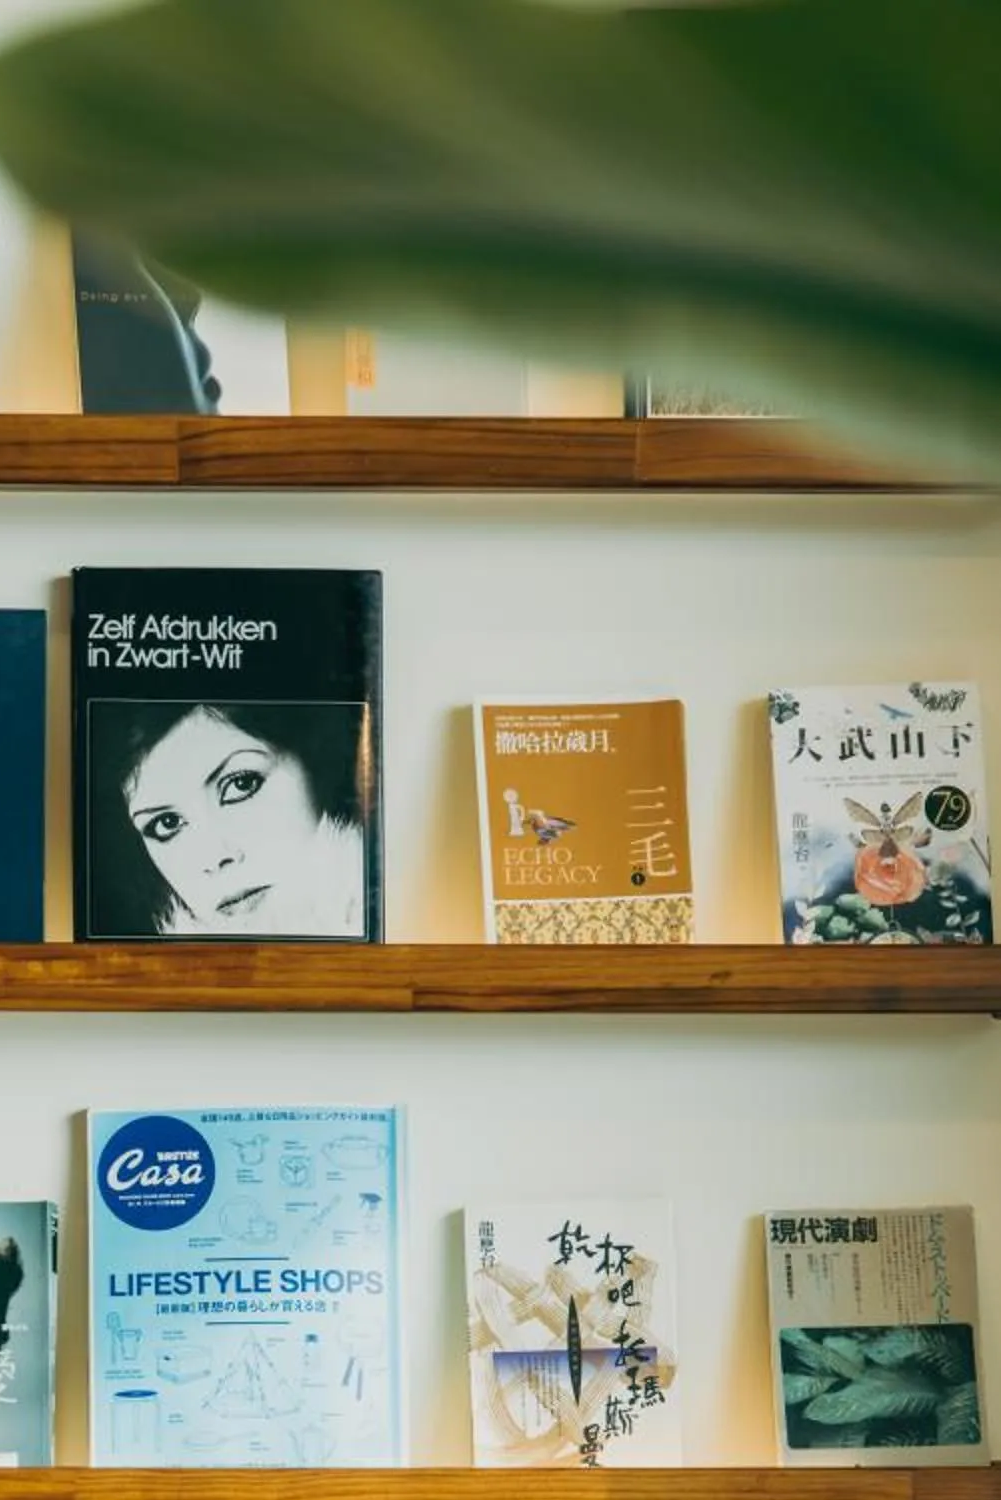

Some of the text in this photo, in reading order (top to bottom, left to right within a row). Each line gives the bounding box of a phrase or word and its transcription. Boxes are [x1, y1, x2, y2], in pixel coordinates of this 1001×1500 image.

[87, 613, 277, 641] Zelf Afdrukken
[87, 643, 244, 669] in Zwart-Wit
[787, 722, 975, 764] 大武山下
[625, 785, 679, 877] 三毛
[503, 846, 573, 866] ECHO
[504, 864, 602, 886] LEGACY
[106, 1148, 206, 1191] Casa
[770, 1215, 879, 1244] 現代演劇
[109, 1269, 384, 1297] LIFESTYLE SHOPS
